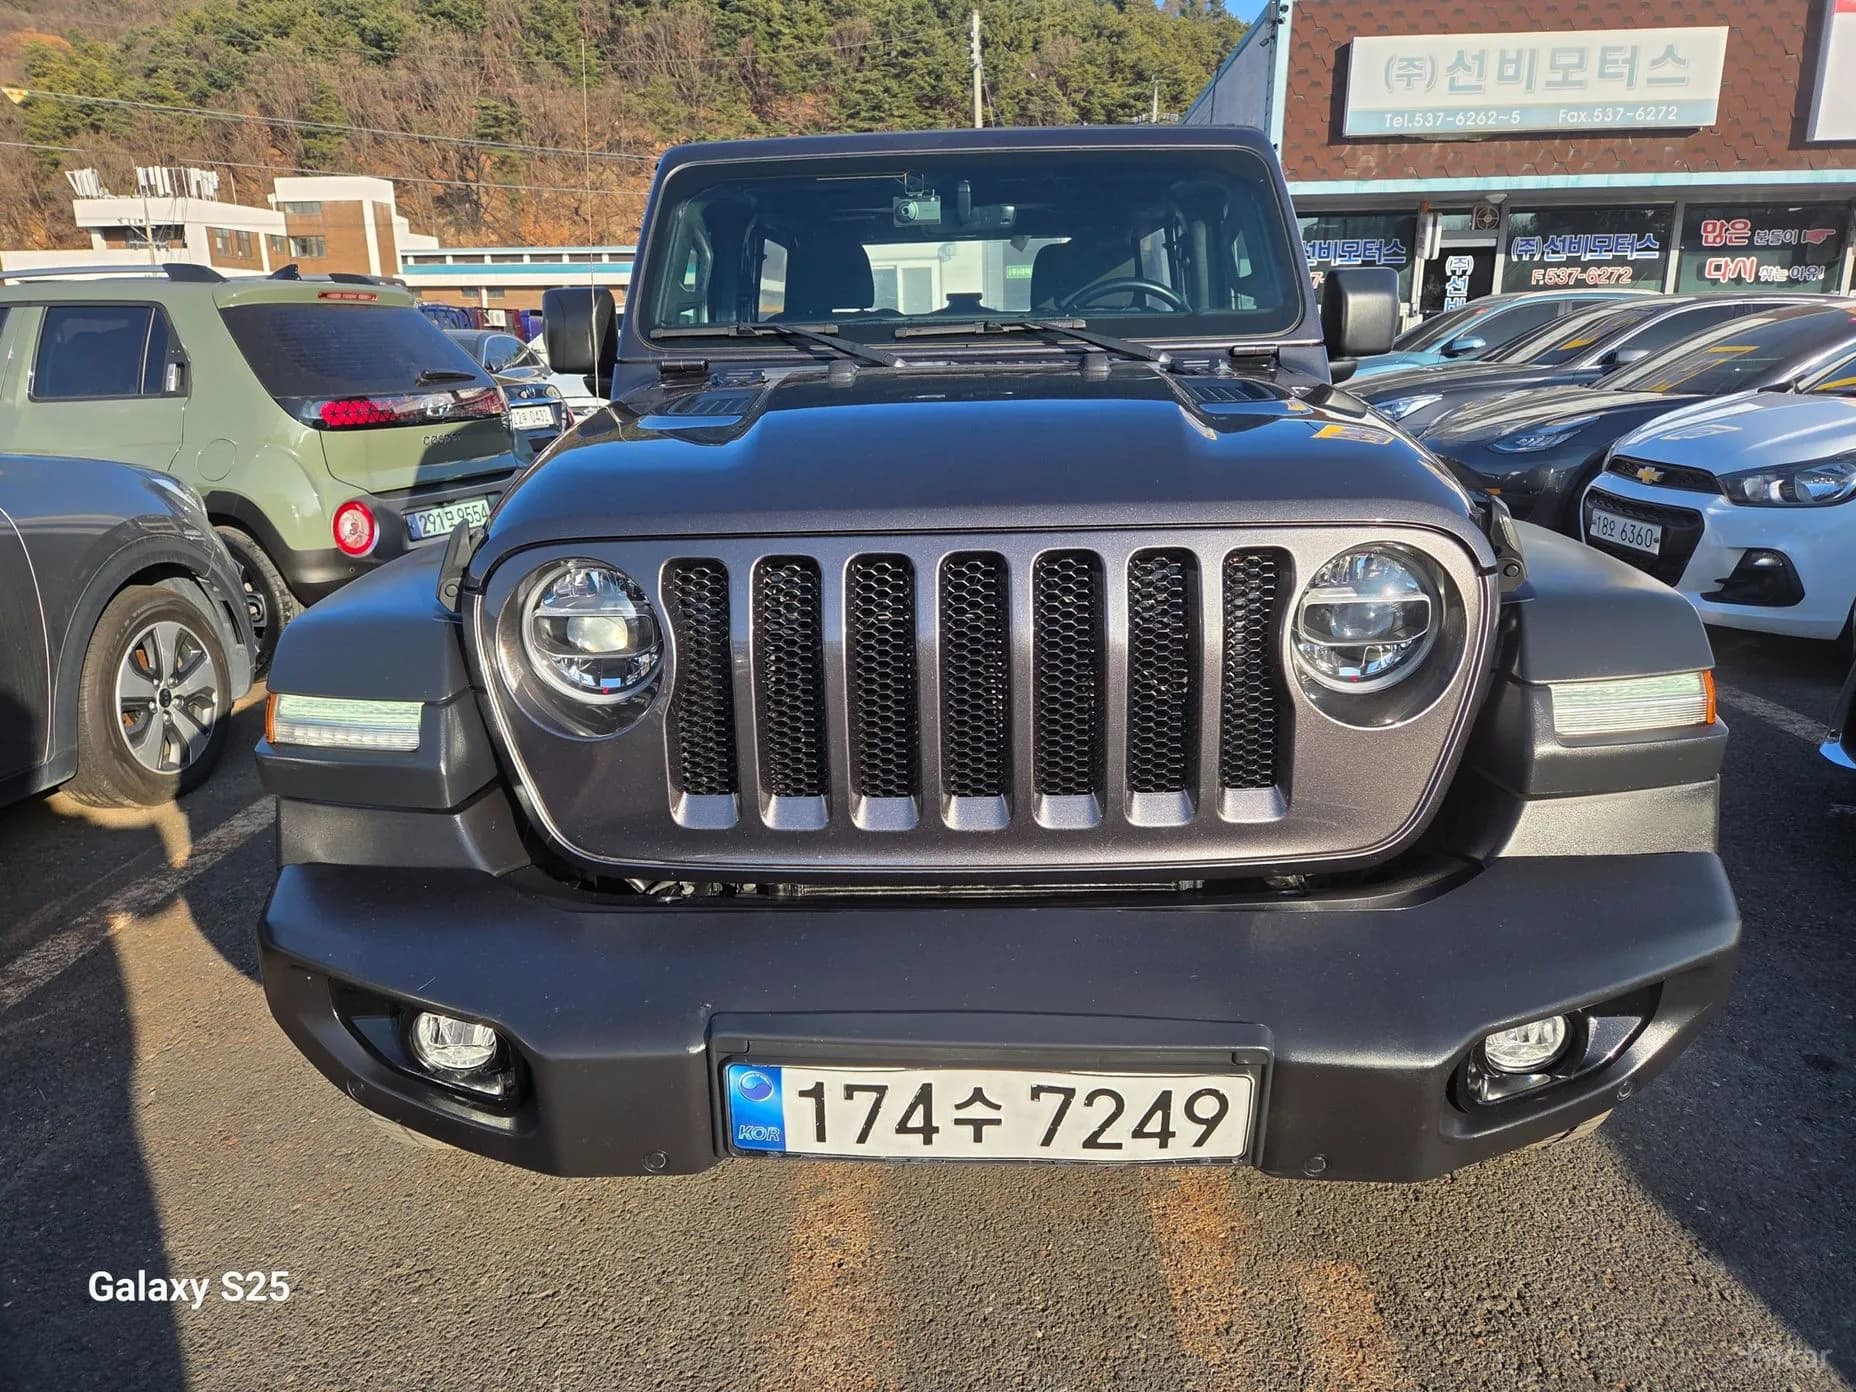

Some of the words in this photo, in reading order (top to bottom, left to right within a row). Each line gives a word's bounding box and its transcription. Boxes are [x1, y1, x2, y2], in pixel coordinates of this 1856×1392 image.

[1558, 106, 1678, 125] Fax.537-6272
[1701, 219, 1751, 246] 많은
[1754, 229, 1798, 245] 분들이
[1531, 266, 1632, 285] F.537-6272
[1705, 256, 1757, 283] 다시
[1620, 522, 1653, 548] 6360
[1029, 1083, 1230, 1150] 7249
[738, 1124, 780, 1141] KOR
